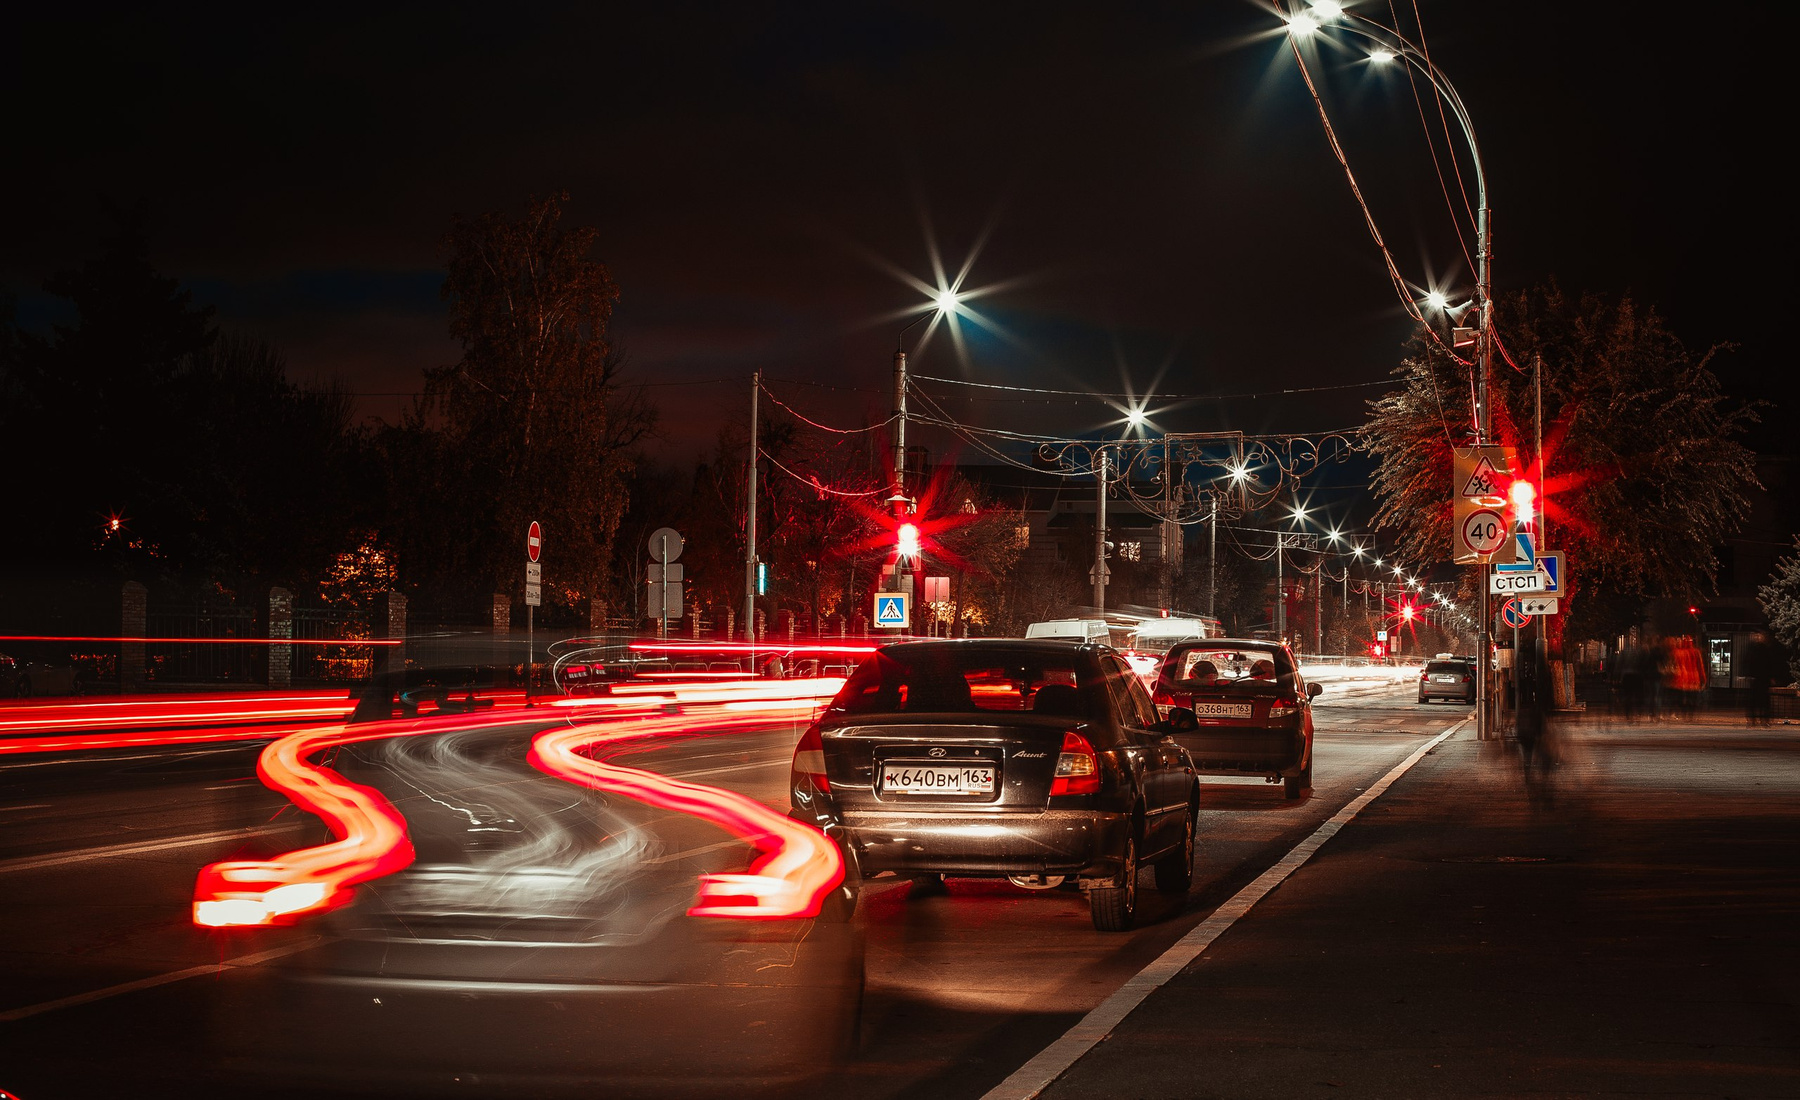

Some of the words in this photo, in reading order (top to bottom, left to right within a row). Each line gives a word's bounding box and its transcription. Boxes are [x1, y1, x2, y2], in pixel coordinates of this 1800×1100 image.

[1470, 522, 1497, 540] 40
[1495, 575, 1537, 590] СТОП
[889, 769, 959, 788] К640ВМ
[963, 769, 988, 783] 163
